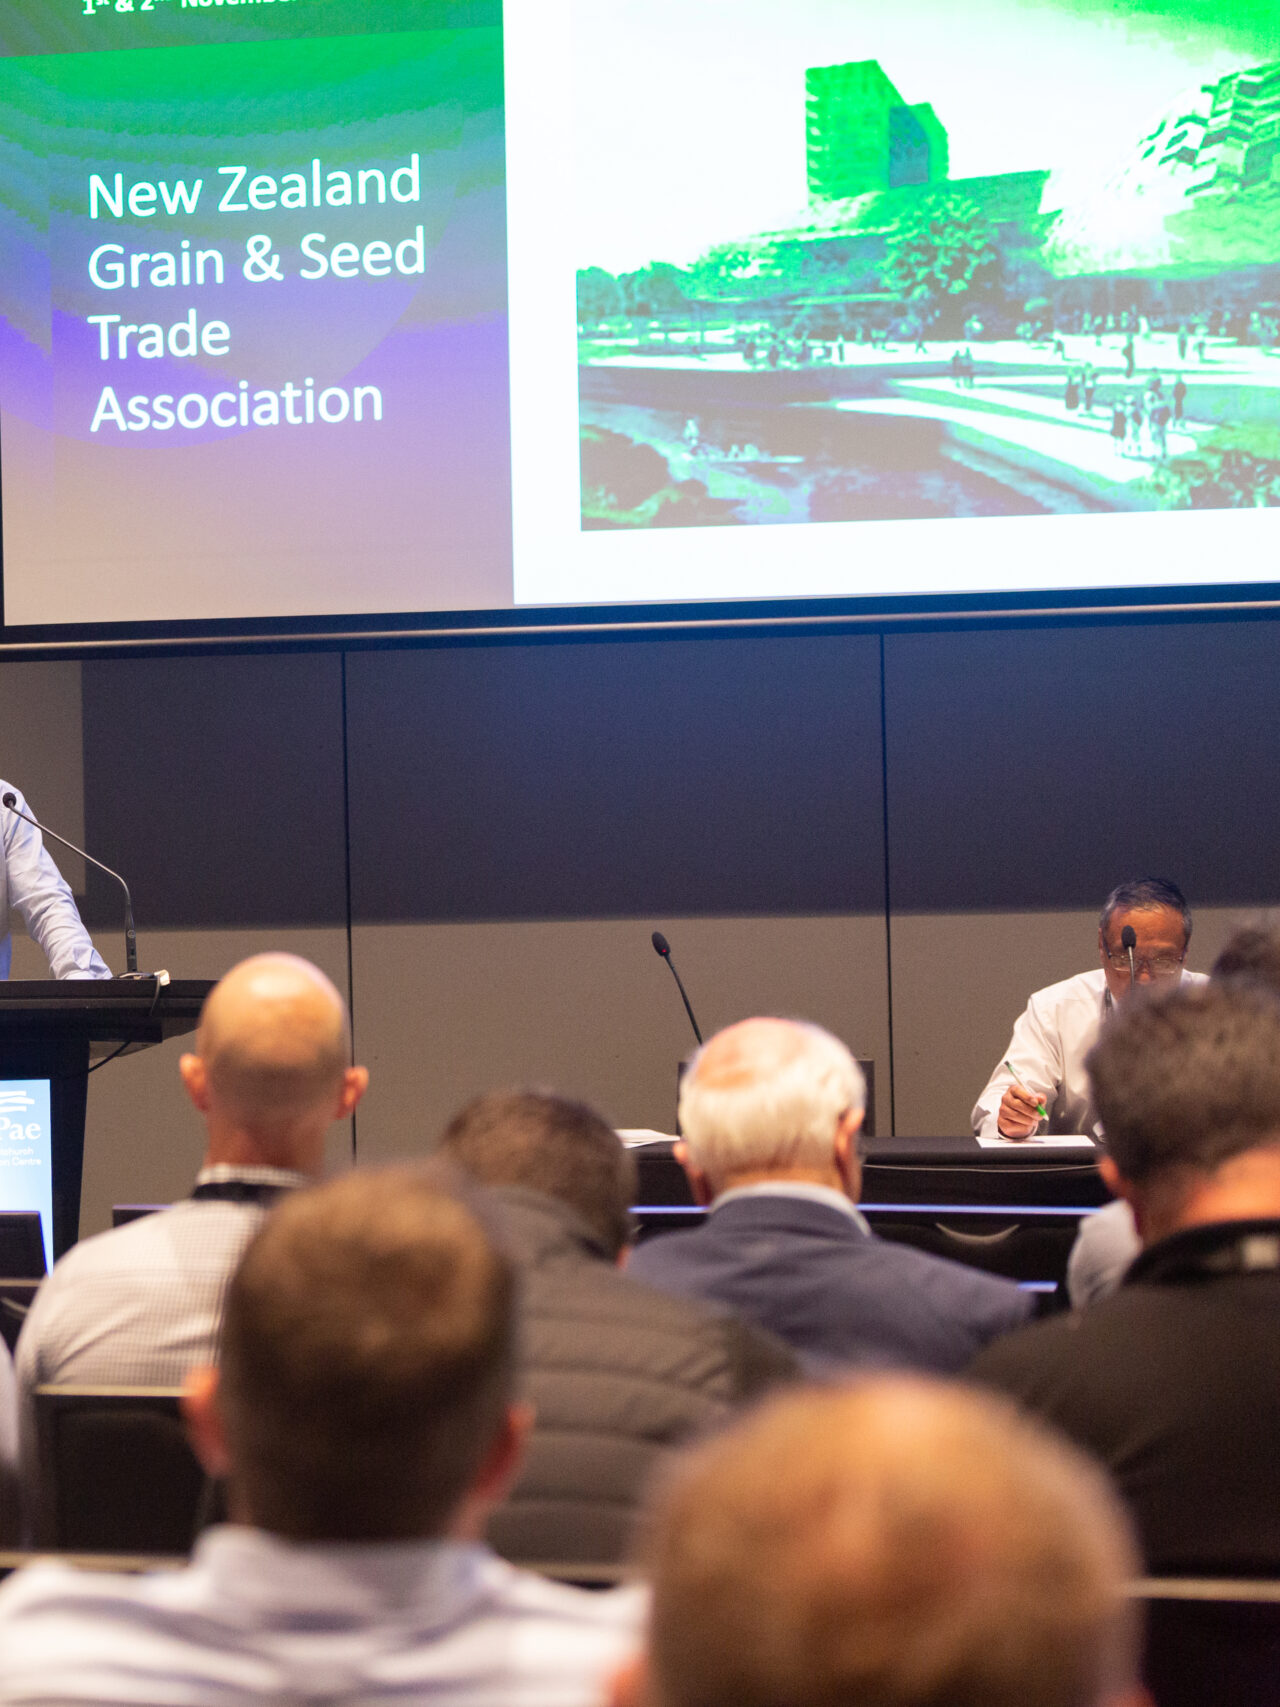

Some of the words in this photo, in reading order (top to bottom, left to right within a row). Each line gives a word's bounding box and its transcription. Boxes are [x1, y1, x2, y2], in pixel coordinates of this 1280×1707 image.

[88, 172, 203, 220] New
[217, 153, 421, 213] Zealand
[87, 240, 224, 290] Grain
[242, 233, 284, 283] &
[299, 225, 426, 279] Seed
[87, 308, 231, 361] Trade
[89, 377, 383, 433] Association
